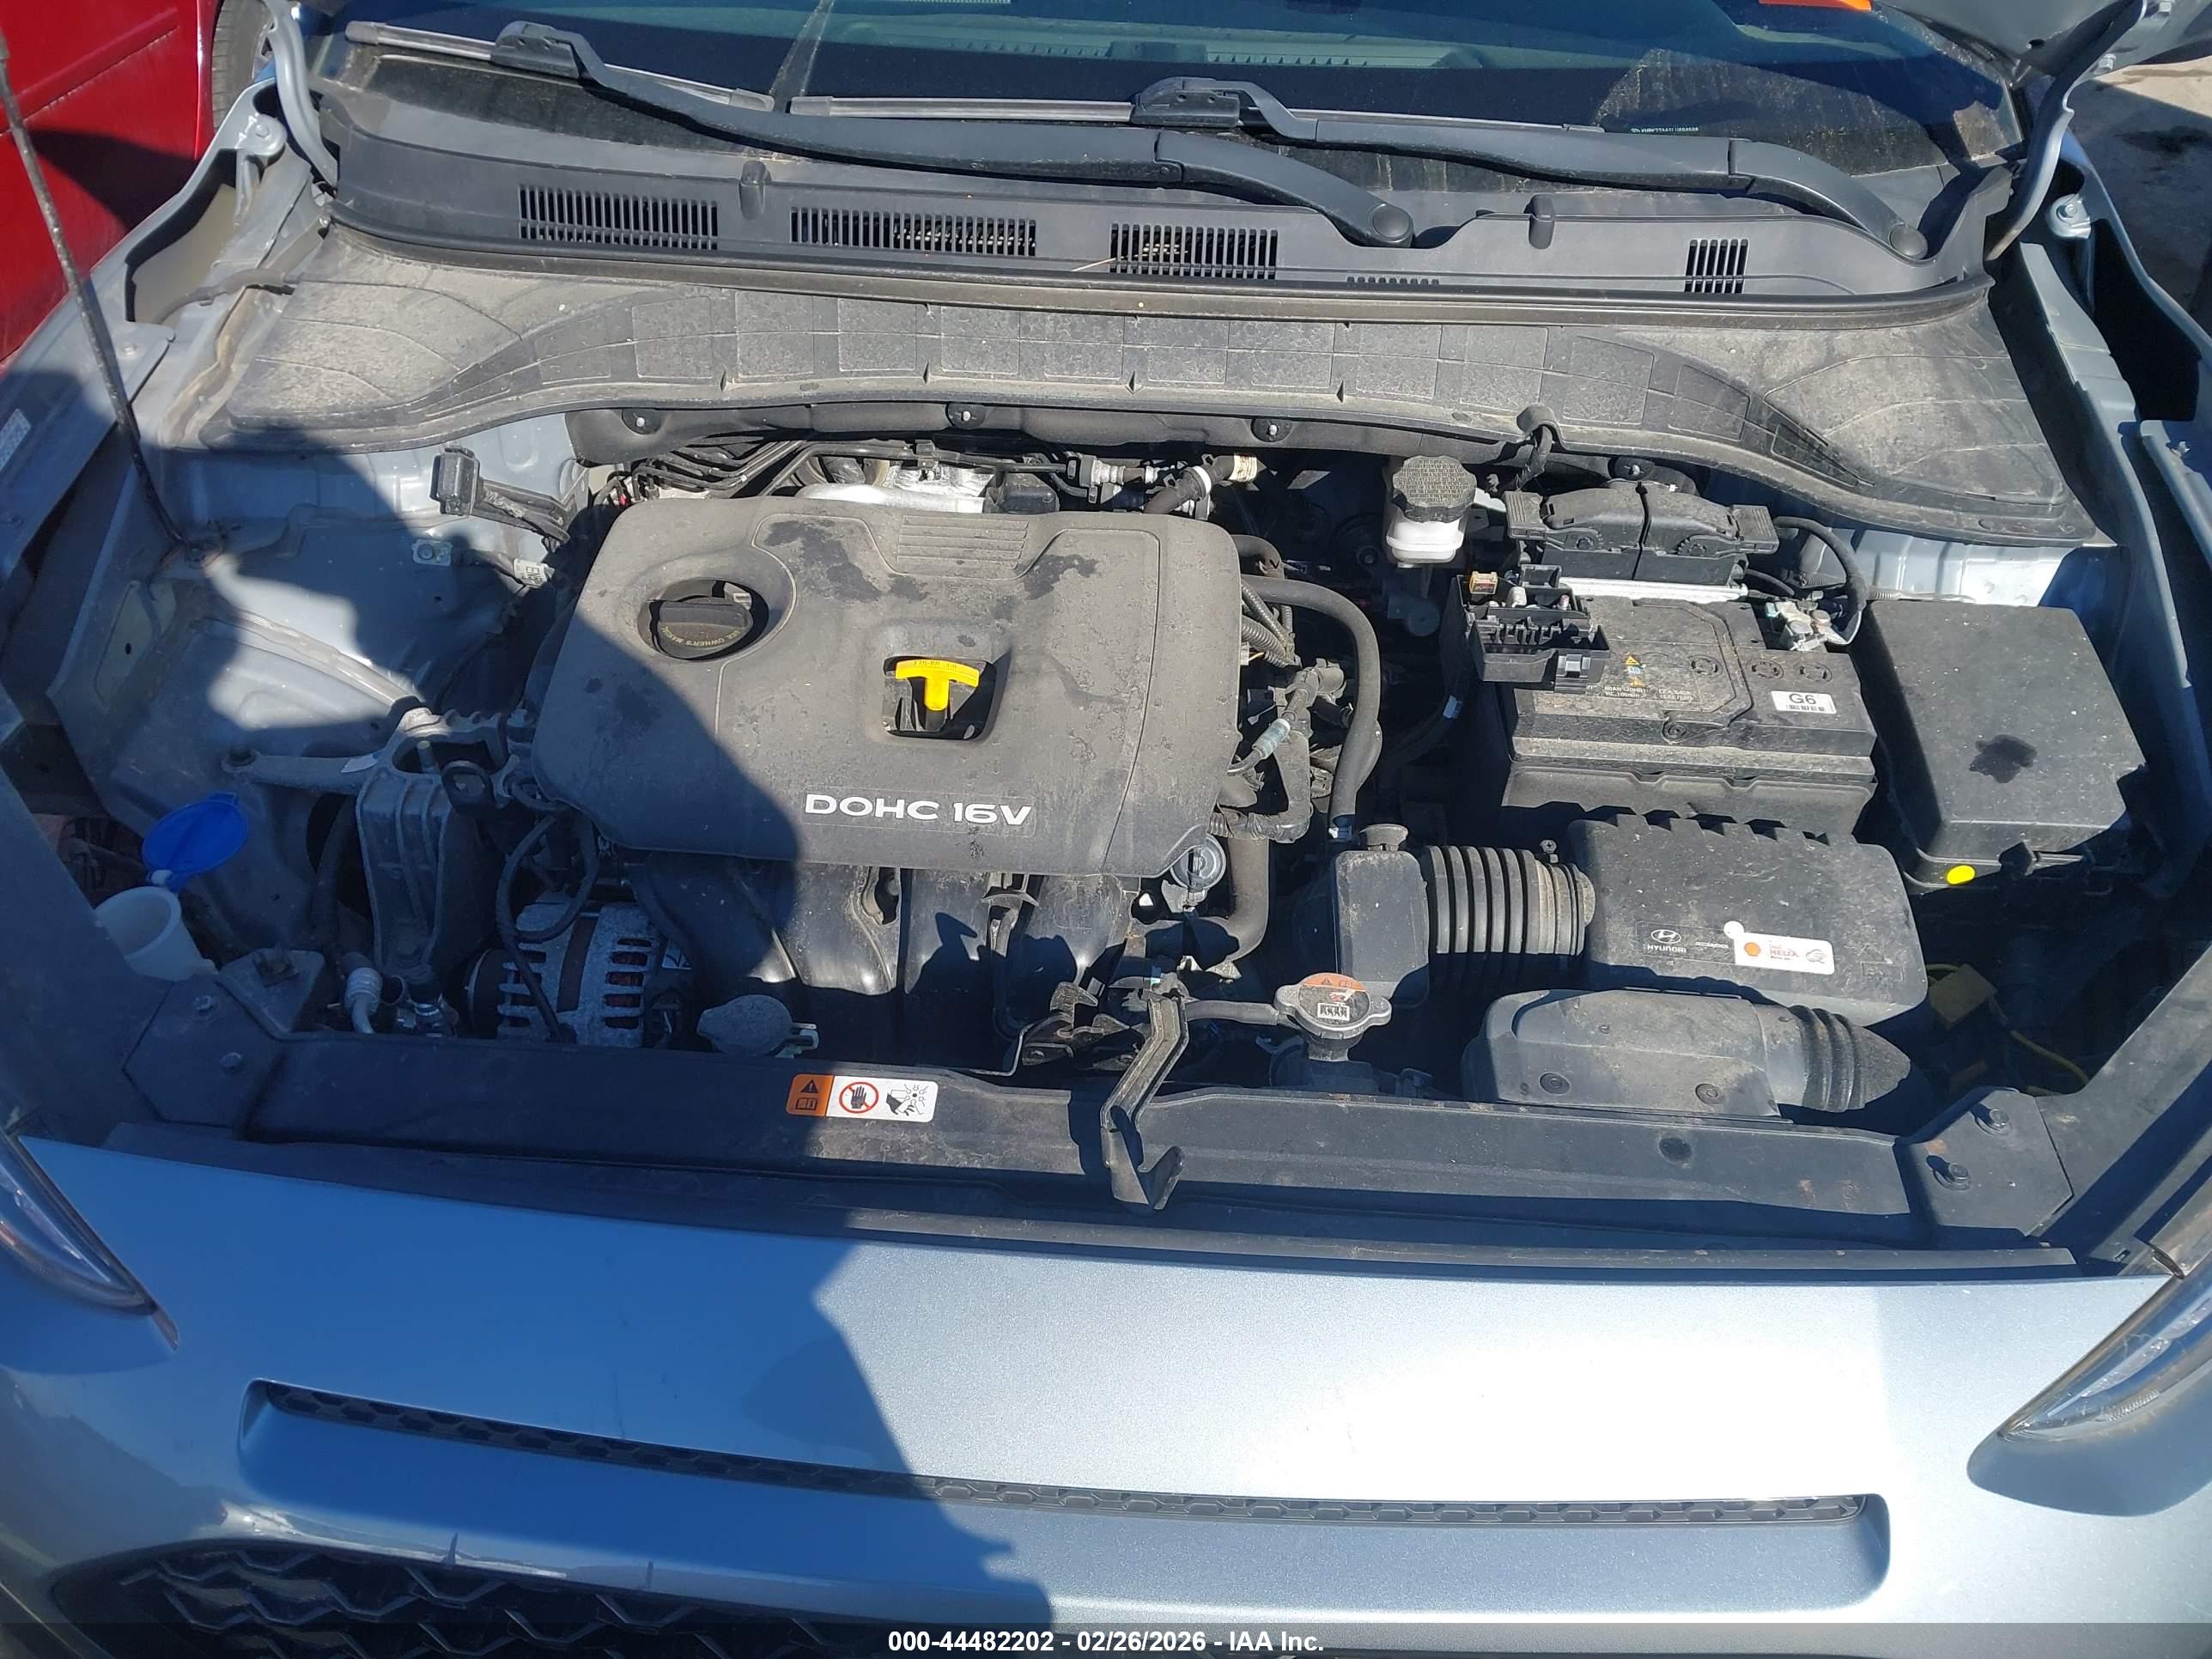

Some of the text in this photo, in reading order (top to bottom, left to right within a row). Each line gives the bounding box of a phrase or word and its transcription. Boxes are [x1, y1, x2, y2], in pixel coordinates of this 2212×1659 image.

[685, 637, 726, 647] OWNER'S
[1789, 693, 1816, 704] G6
[805, 793, 1032, 825] DOHC 16V
[1647, 944, 1687, 953] HYUNDAI
